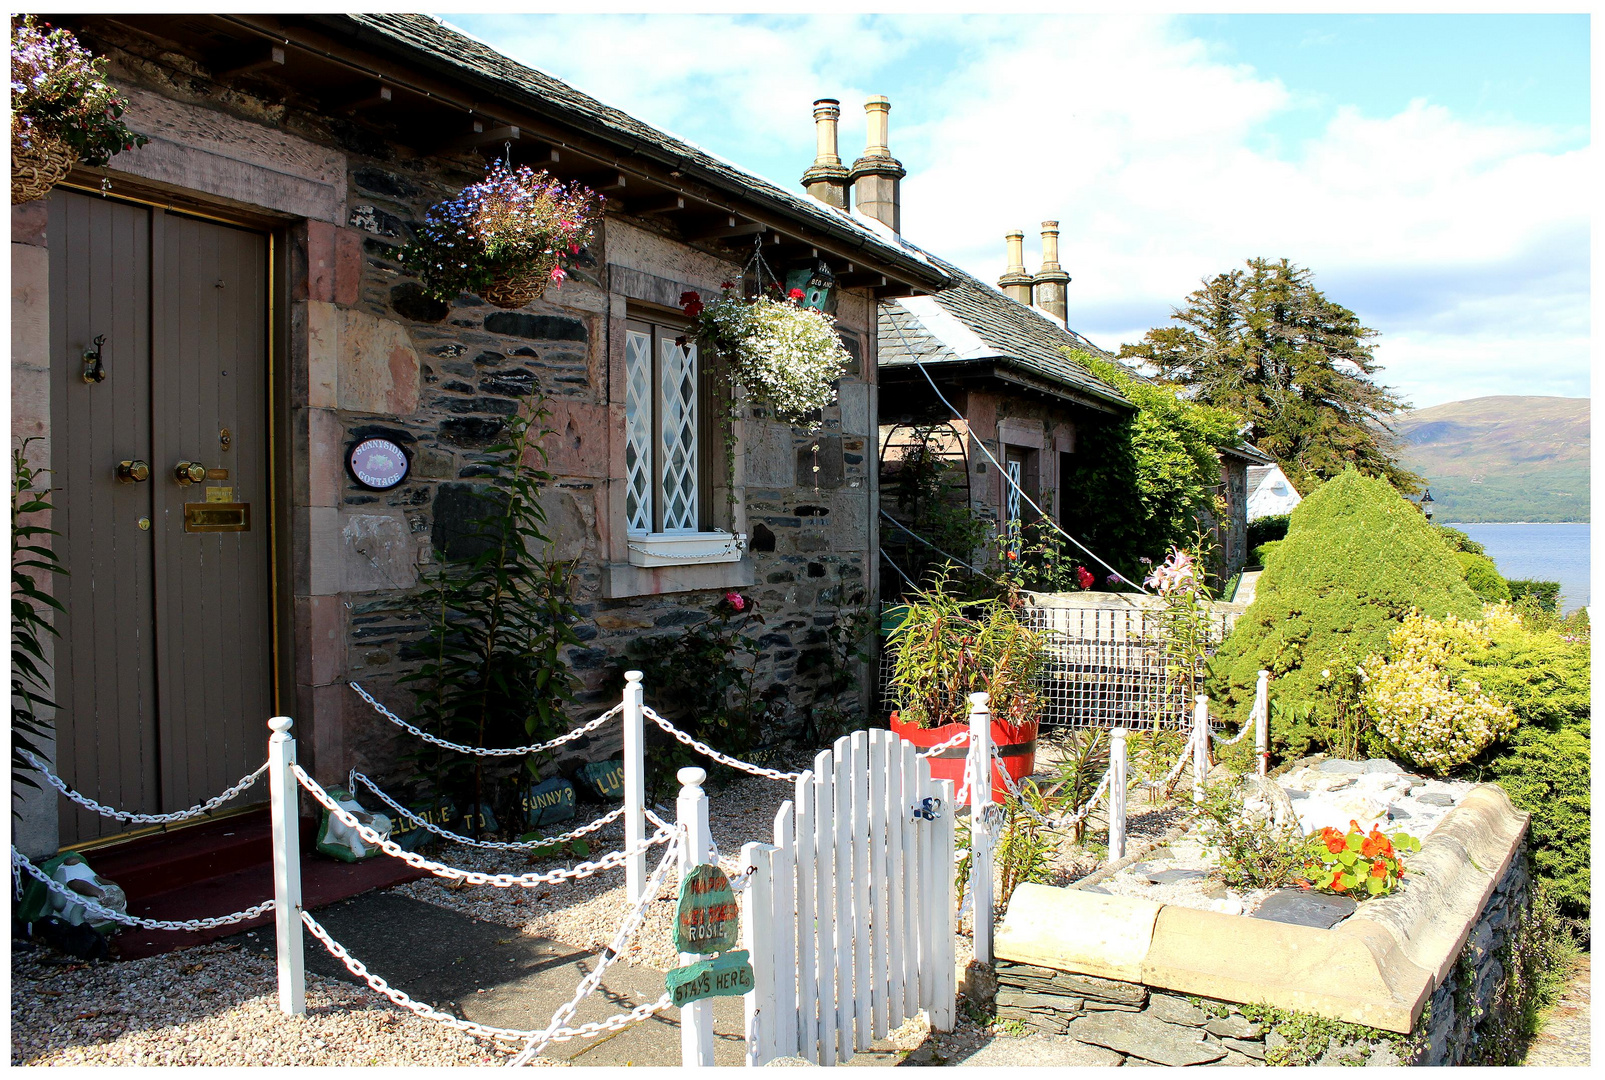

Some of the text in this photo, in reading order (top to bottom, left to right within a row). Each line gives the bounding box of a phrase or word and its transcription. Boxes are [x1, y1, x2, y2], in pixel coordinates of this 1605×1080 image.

[355, 440, 404, 460] SUNNYSIDE
[358, 470, 401, 486] COTTAGE
[596, 767, 625, 795] LUS
